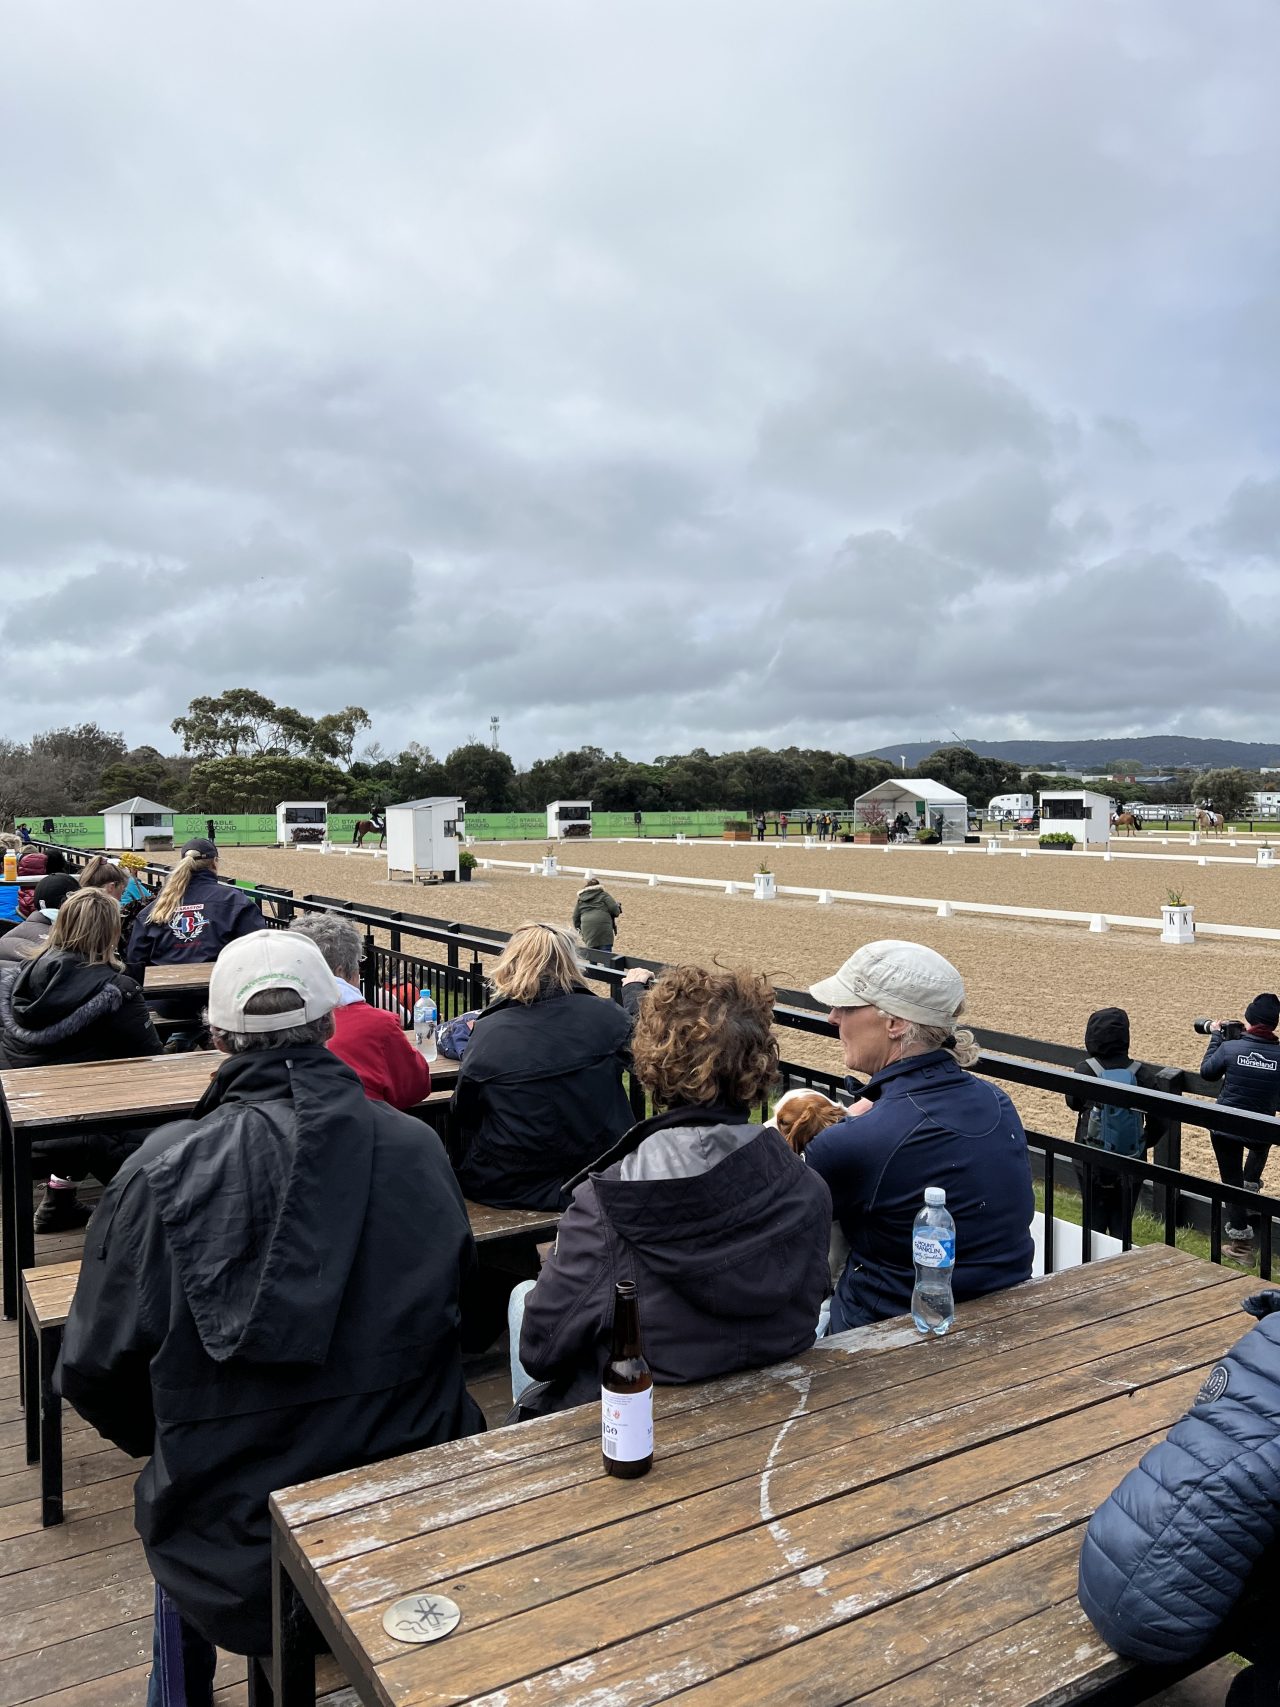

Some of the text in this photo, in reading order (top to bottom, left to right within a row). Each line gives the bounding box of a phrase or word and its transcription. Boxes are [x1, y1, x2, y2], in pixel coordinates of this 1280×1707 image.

[765, 878, 770, 887] V
[1169, 912, 1175, 925] K
[1183, 912, 1188, 925] K
[1240, 1057, 1274, 1069] Horseland
